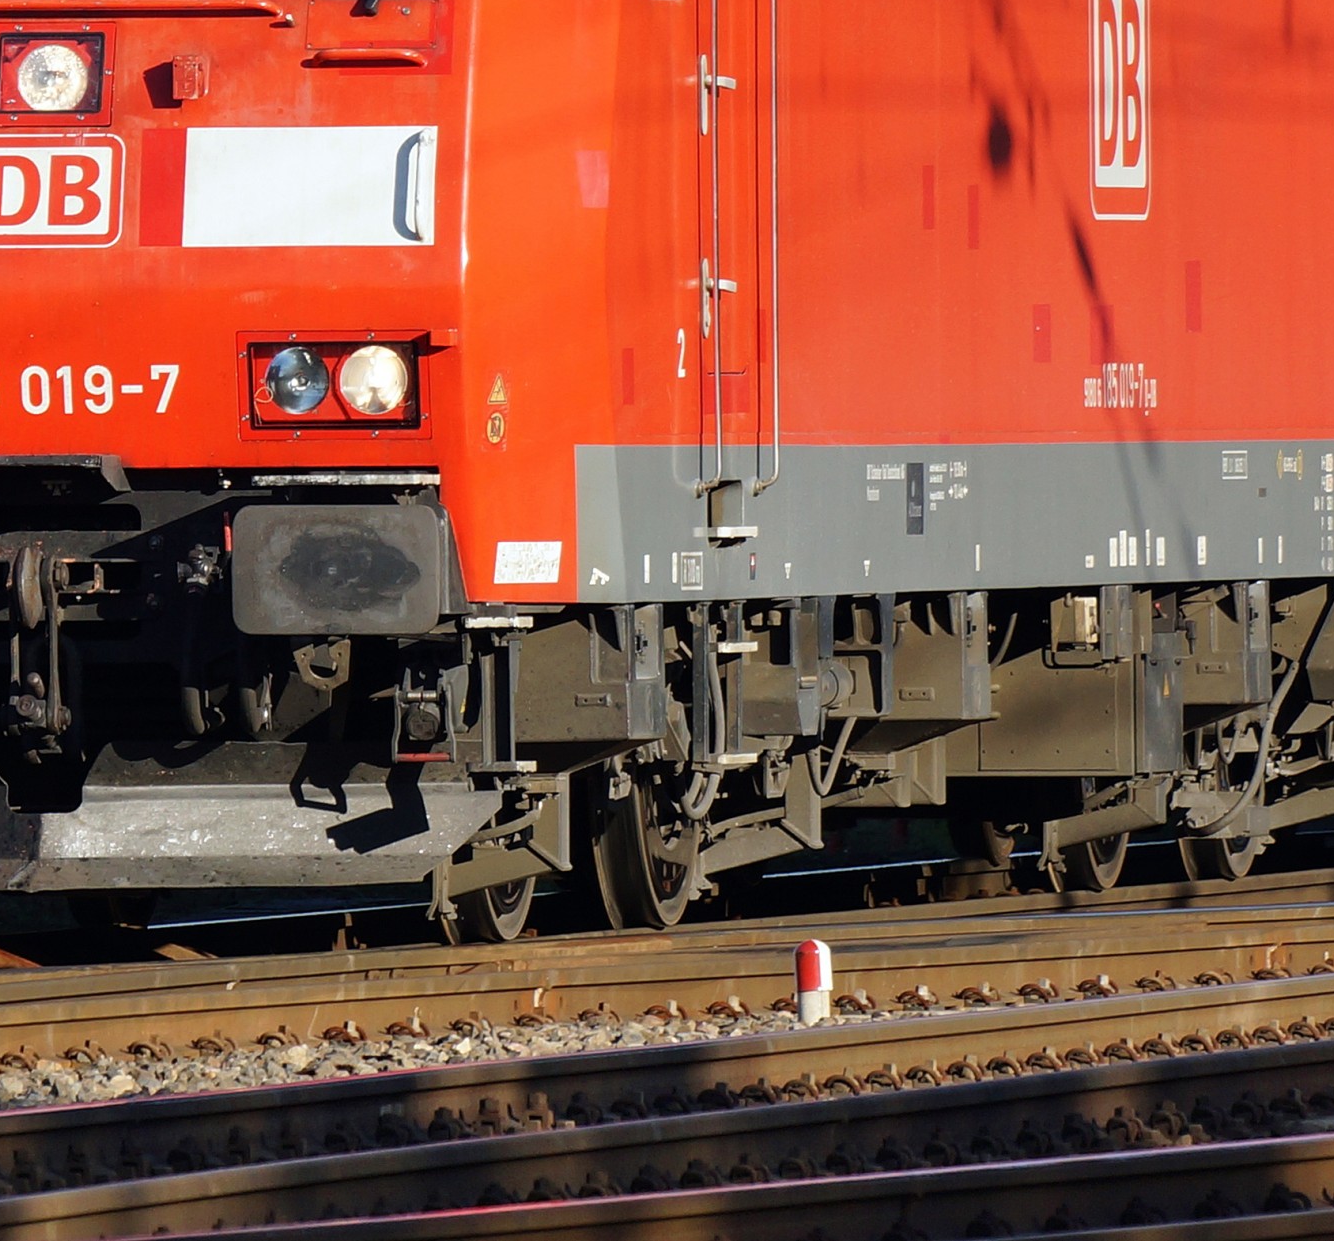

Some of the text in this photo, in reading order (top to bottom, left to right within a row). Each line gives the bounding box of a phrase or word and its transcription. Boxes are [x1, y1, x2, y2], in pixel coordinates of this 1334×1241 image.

[676, 328, 686, 378] 2
[20, 364, 180, 415] 019-7
[1103, 363, 1117, 408] 185
[1120, 363, 1144, 408] 019-7
